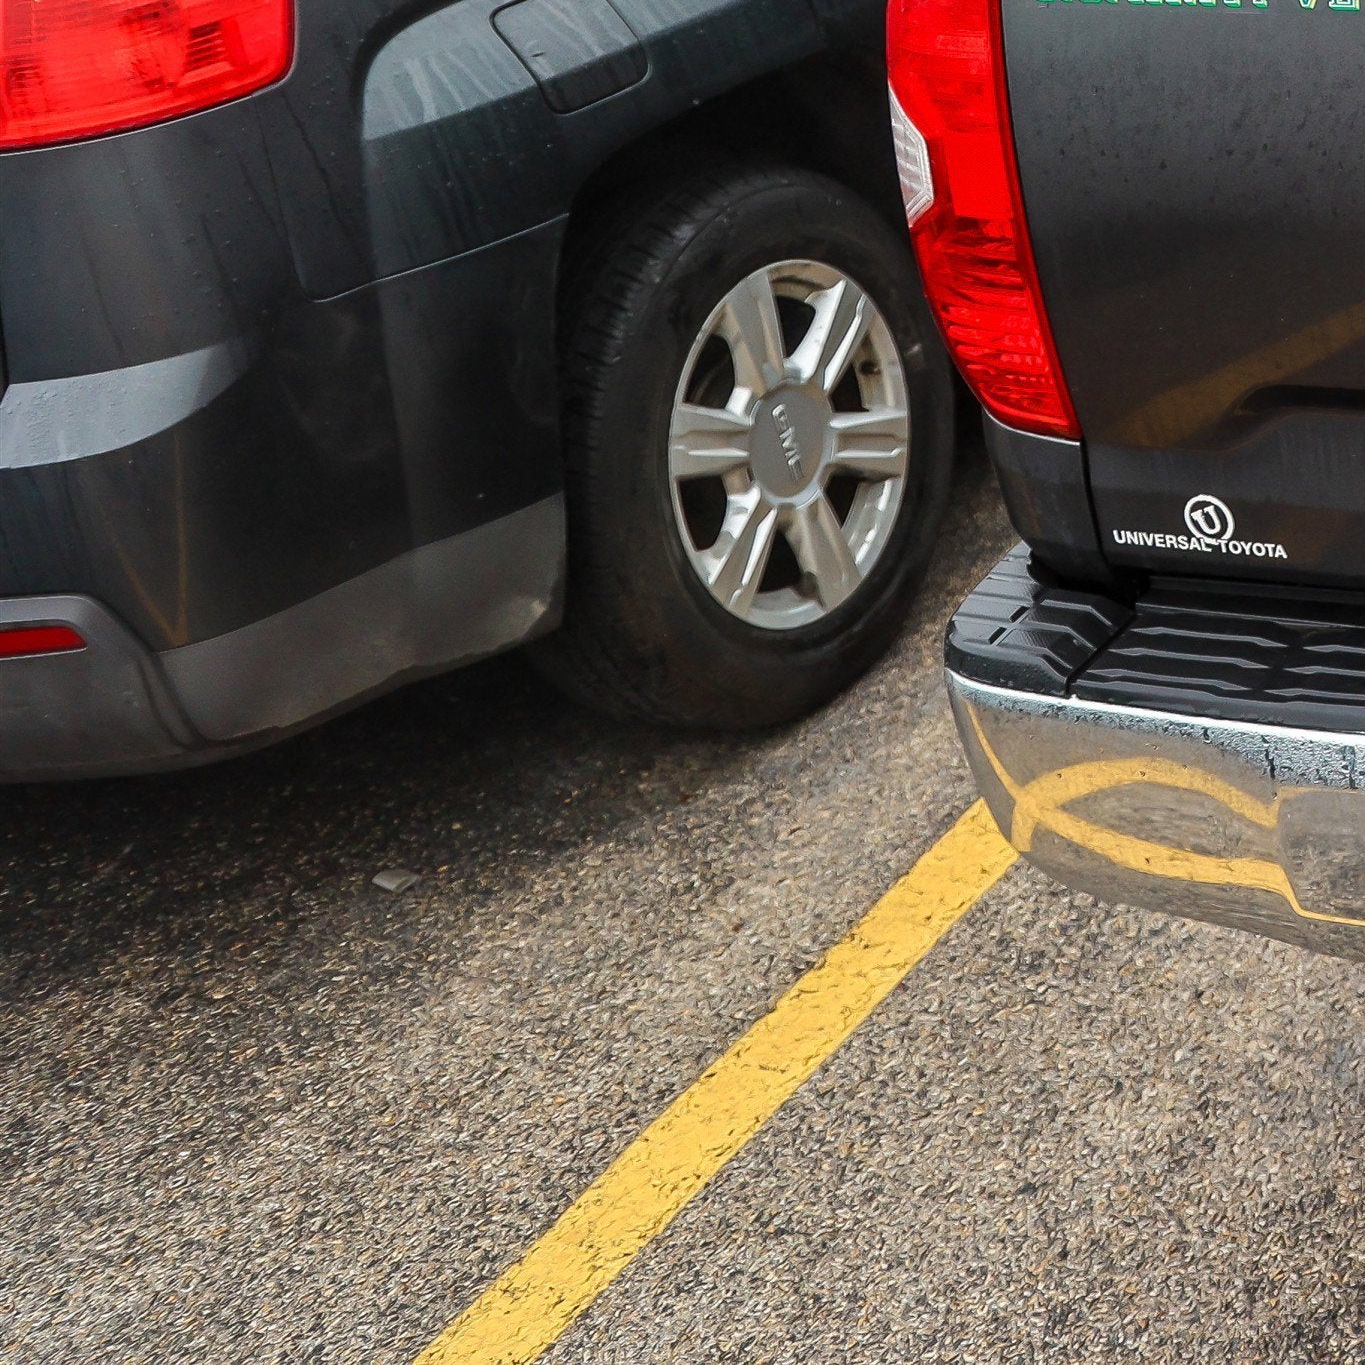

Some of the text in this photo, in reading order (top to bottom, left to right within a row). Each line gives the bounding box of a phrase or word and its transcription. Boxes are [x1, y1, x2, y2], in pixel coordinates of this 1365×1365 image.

[771, 403, 805, 485] GMC
[1112, 529, 1288, 559] UNIVERSAL TOYOTA
